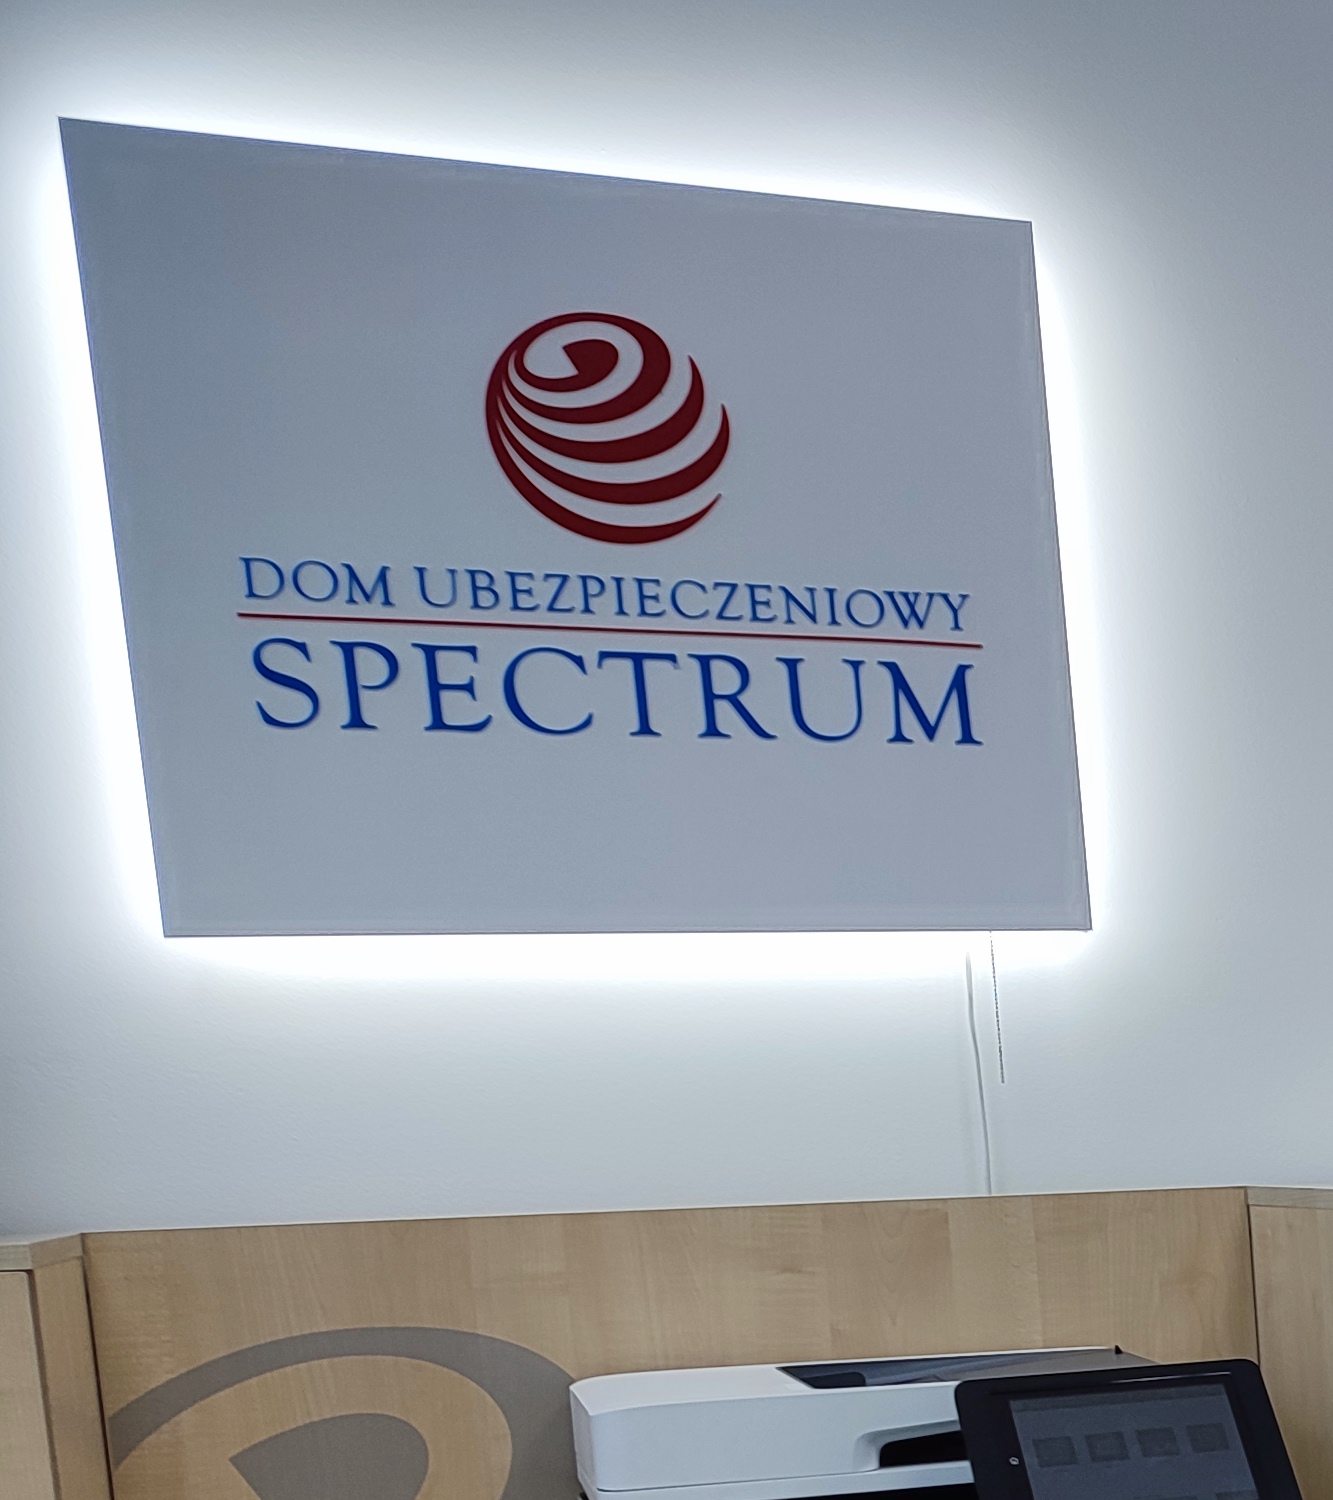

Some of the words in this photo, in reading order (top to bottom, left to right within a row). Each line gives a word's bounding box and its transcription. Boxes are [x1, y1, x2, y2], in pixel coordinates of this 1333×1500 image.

[238, 556, 395, 607] DOM
[412, 564, 971, 632] UBEZPIECZENIOWY
[251, 636, 984, 747] SPECTRUM
